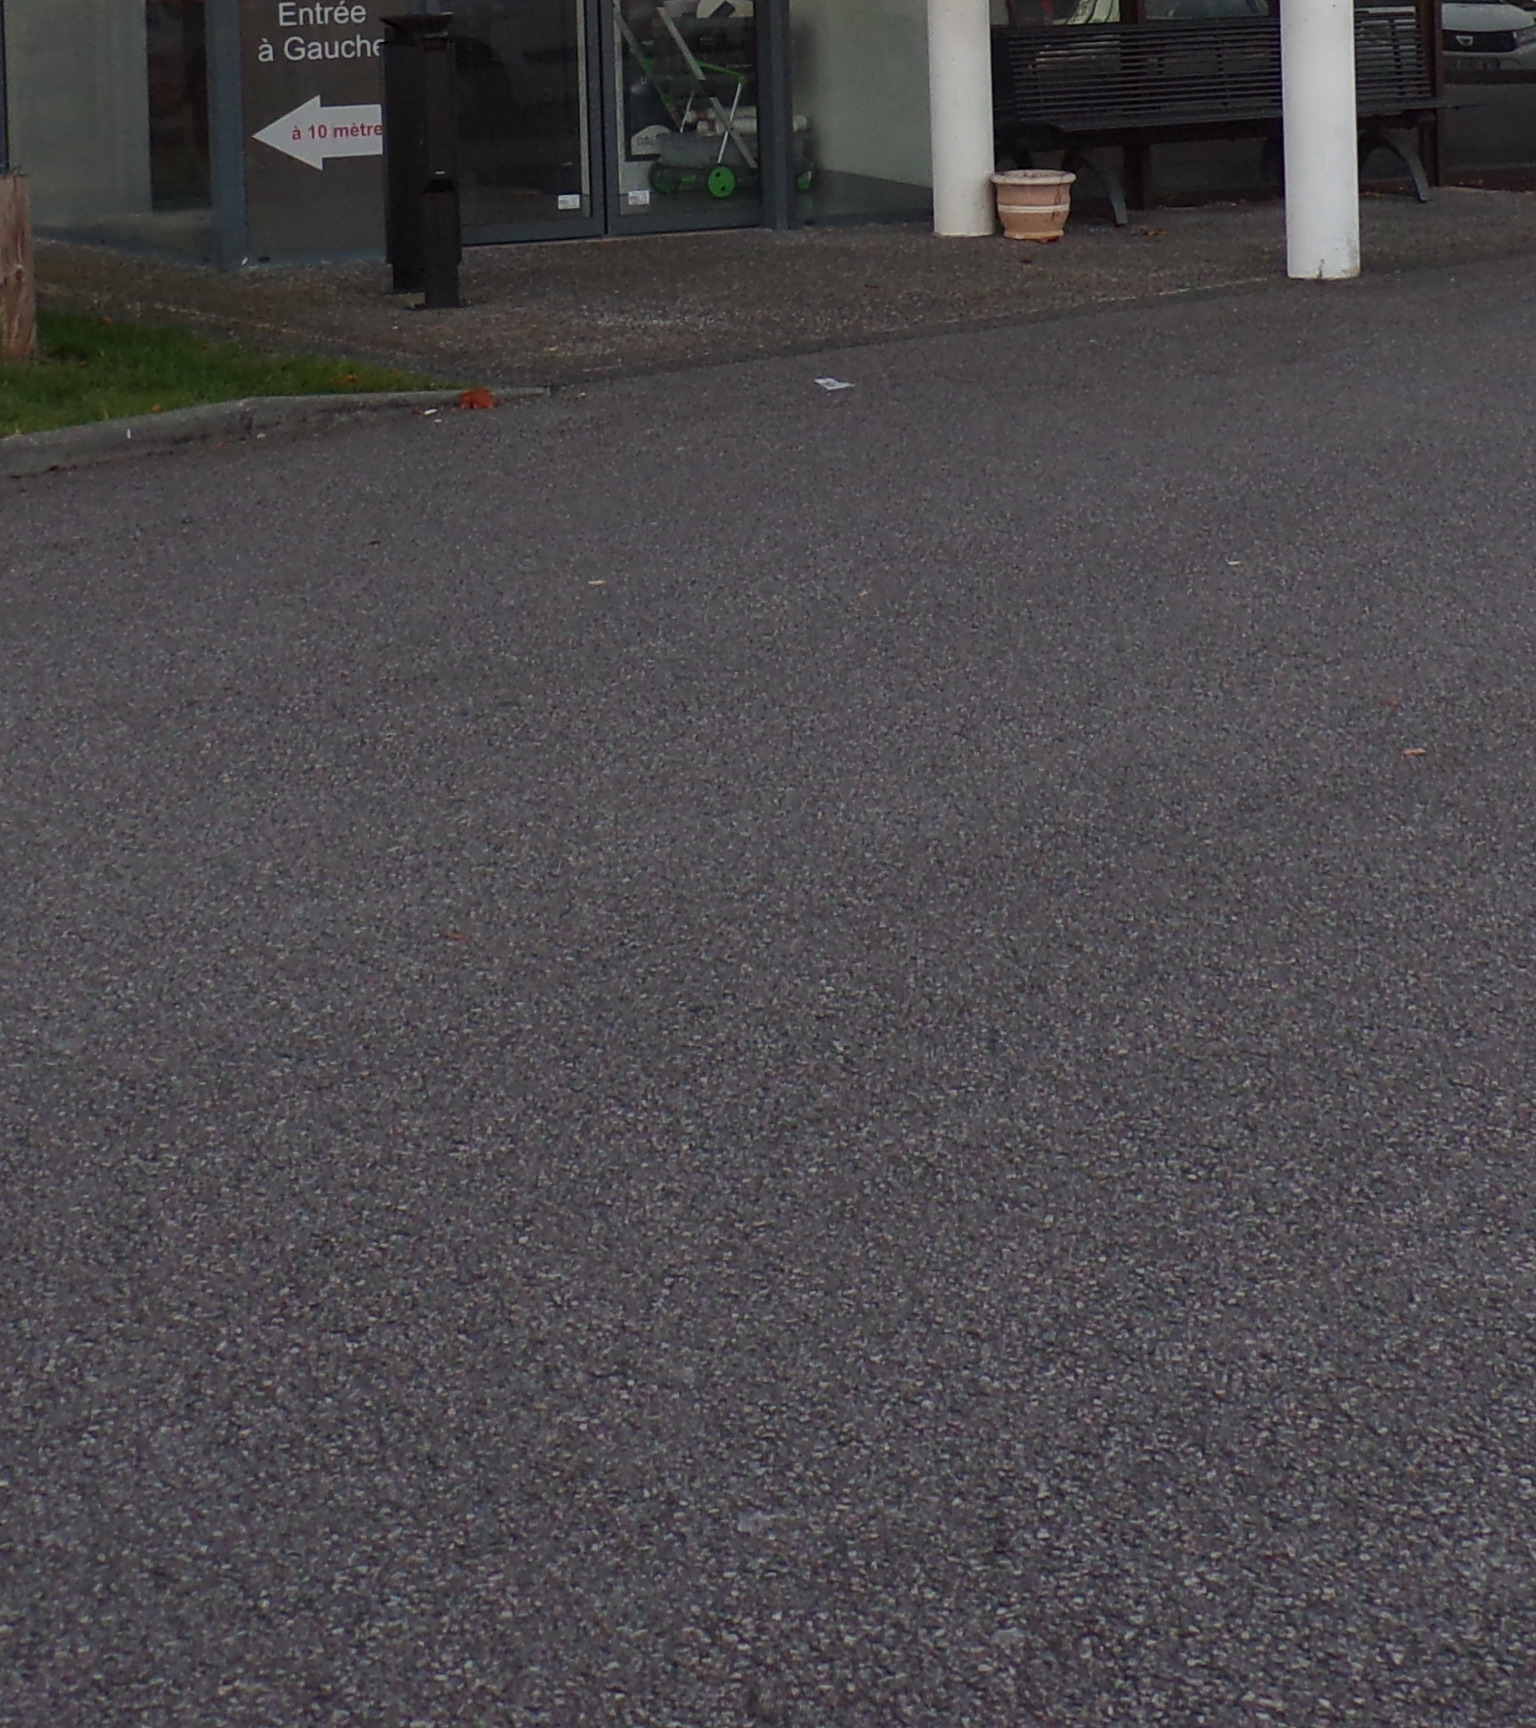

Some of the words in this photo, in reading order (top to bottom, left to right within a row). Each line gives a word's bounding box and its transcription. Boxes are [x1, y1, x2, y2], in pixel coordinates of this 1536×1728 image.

[278, 0, 367, 27] Entrée
[258, 37, 274, 62] à
[283, 33, 385, 61] Gauche
[292, 125, 302, 141] à
[308, 124, 328, 140] 10
[333, 122, 384, 139] mètre
